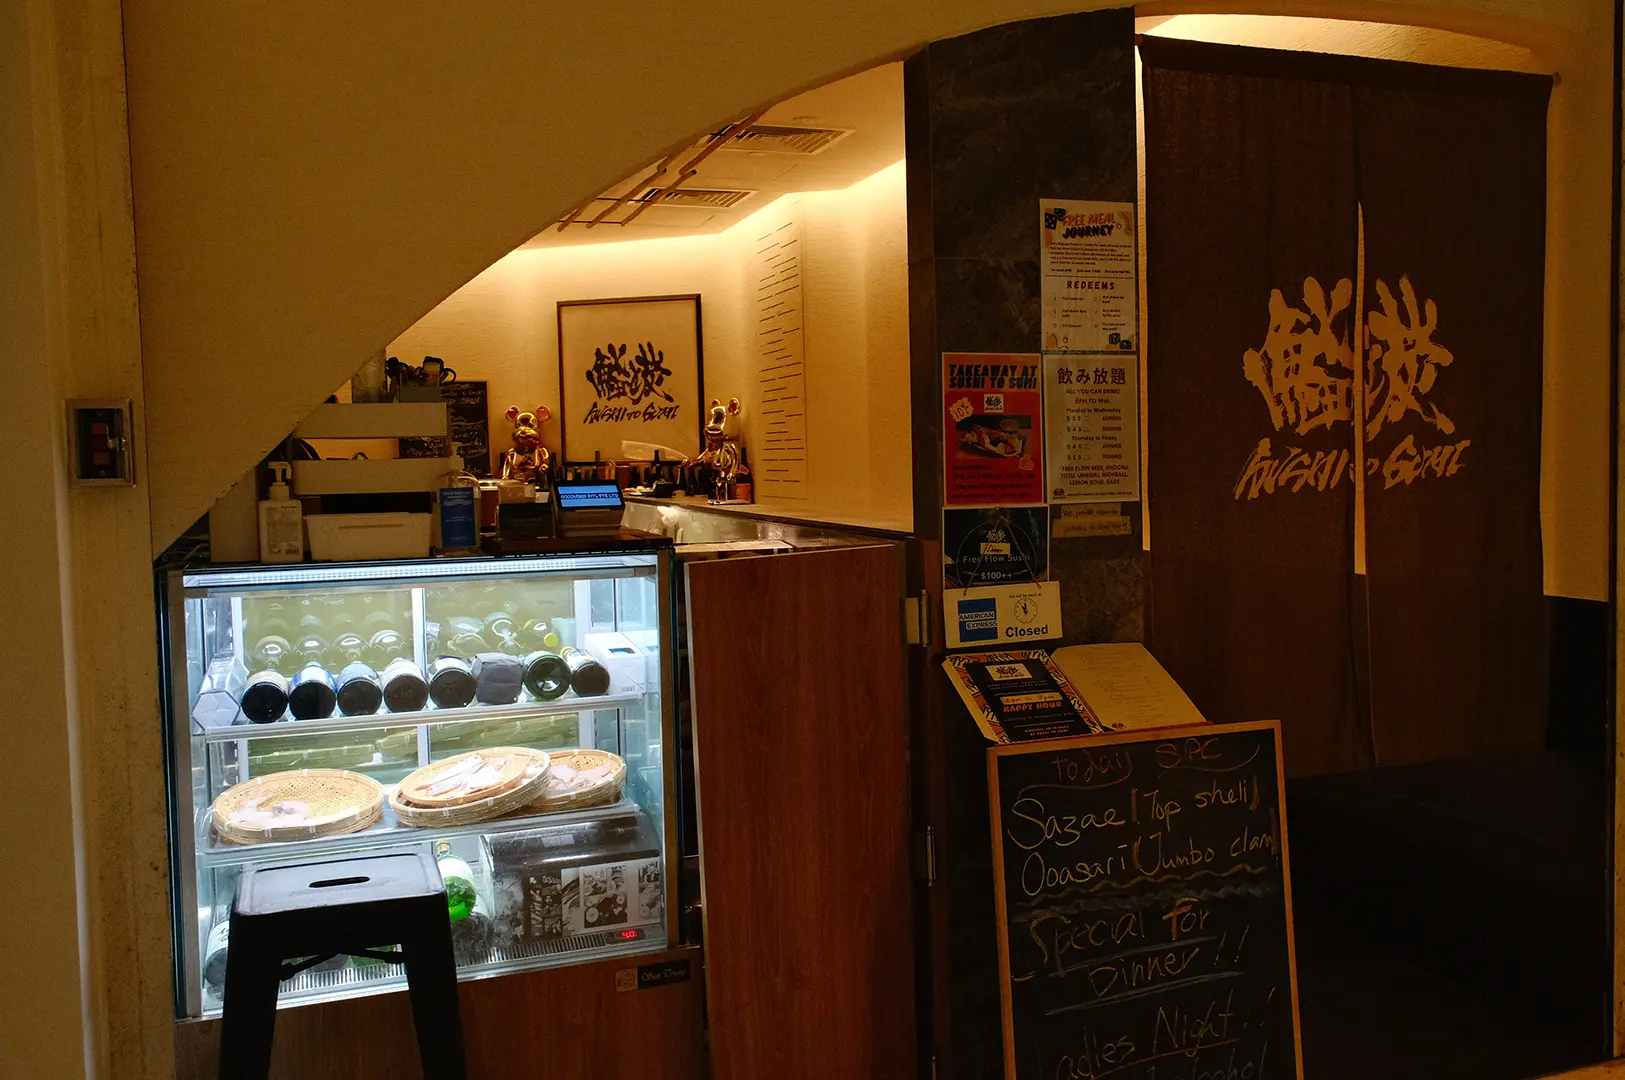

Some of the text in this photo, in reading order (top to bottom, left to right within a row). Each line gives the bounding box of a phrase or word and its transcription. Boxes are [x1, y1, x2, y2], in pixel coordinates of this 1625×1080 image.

[1063, 212, 1116, 227] FREE MEAL
[1062, 225, 1114, 239] JOURNEY
[1066, 280, 1115, 290] REDEEMS
[949, 364, 1038, 377] TAKEAWAY AT
[1057, 367, 1126, 386] 飲み放題
[949, 376, 1037, 389] SUSHI TO SUMI
[953, 402, 969, 419] 10%
[984, 554, 1004, 563] Flow
[1007, 553, 1030, 562] Sushi
[980, 571, 1013, 580] $100++
[959, 611, 994, 620] AMERICAN
[967, 621, 998, 630] EXPRESS
[1005, 624, 1048, 638] Closed
[1003, 701, 1063, 713] HAPPY HOUR
[1052, 750, 1132, 788] today
[1007, 798, 1126, 850] Sazae
[1011, 896, 1210, 980] Special For
